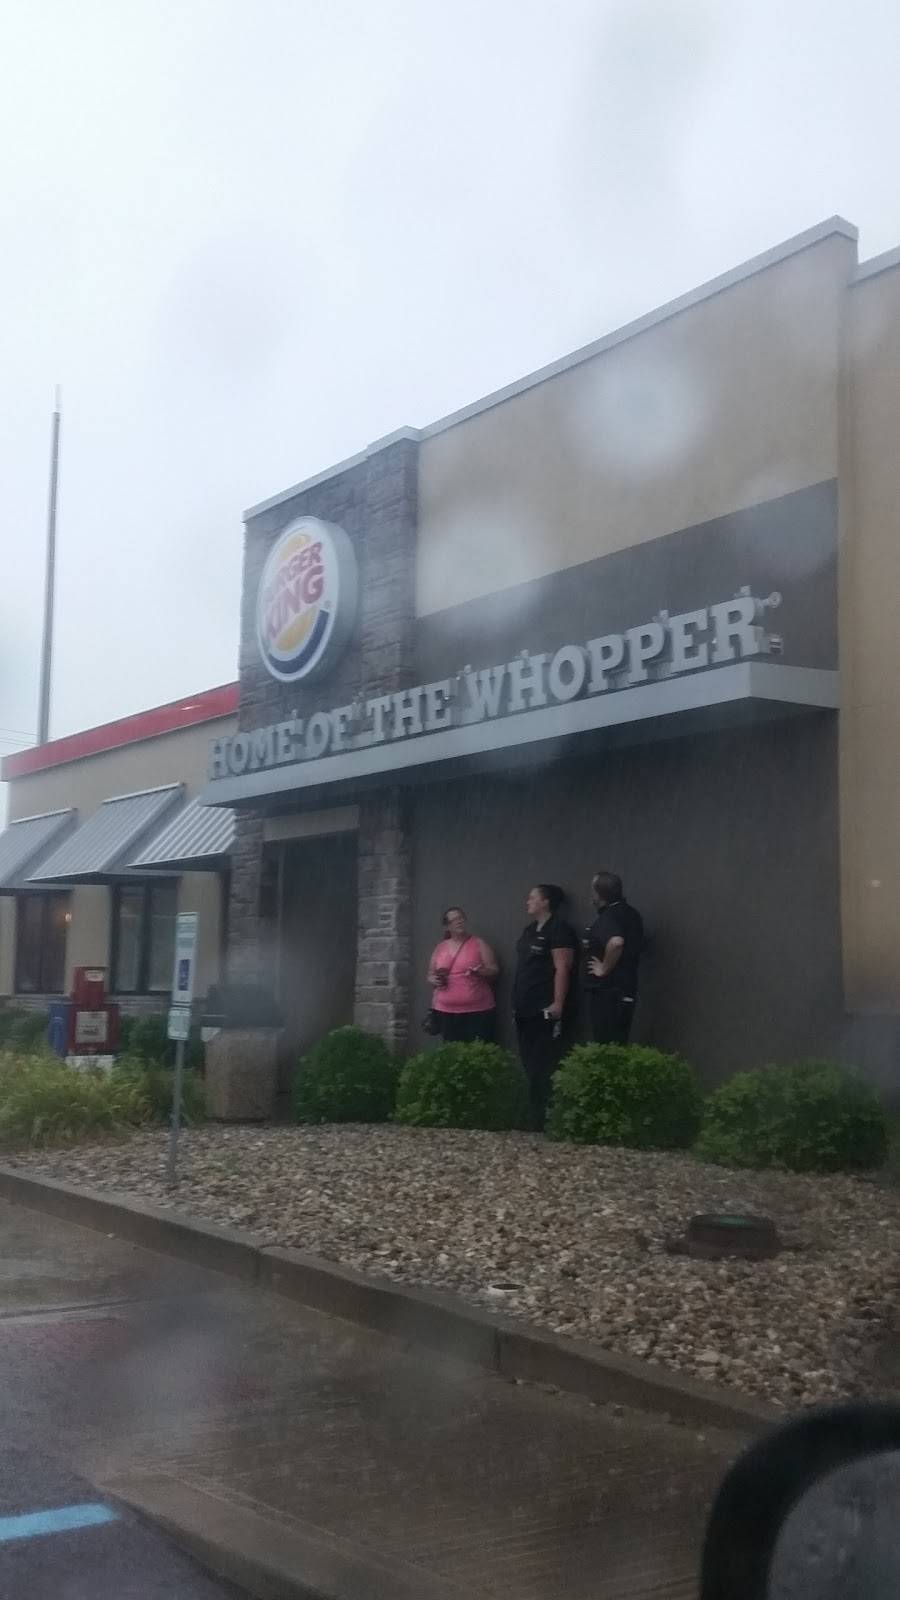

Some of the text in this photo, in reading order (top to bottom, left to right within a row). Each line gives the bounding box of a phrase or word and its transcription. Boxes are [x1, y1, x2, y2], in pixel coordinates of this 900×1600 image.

[264, 565, 325, 637] KING
[265, 542, 322, 604] RGER
[209, 595, 760, 777] HOME OF THE WHOPPER
